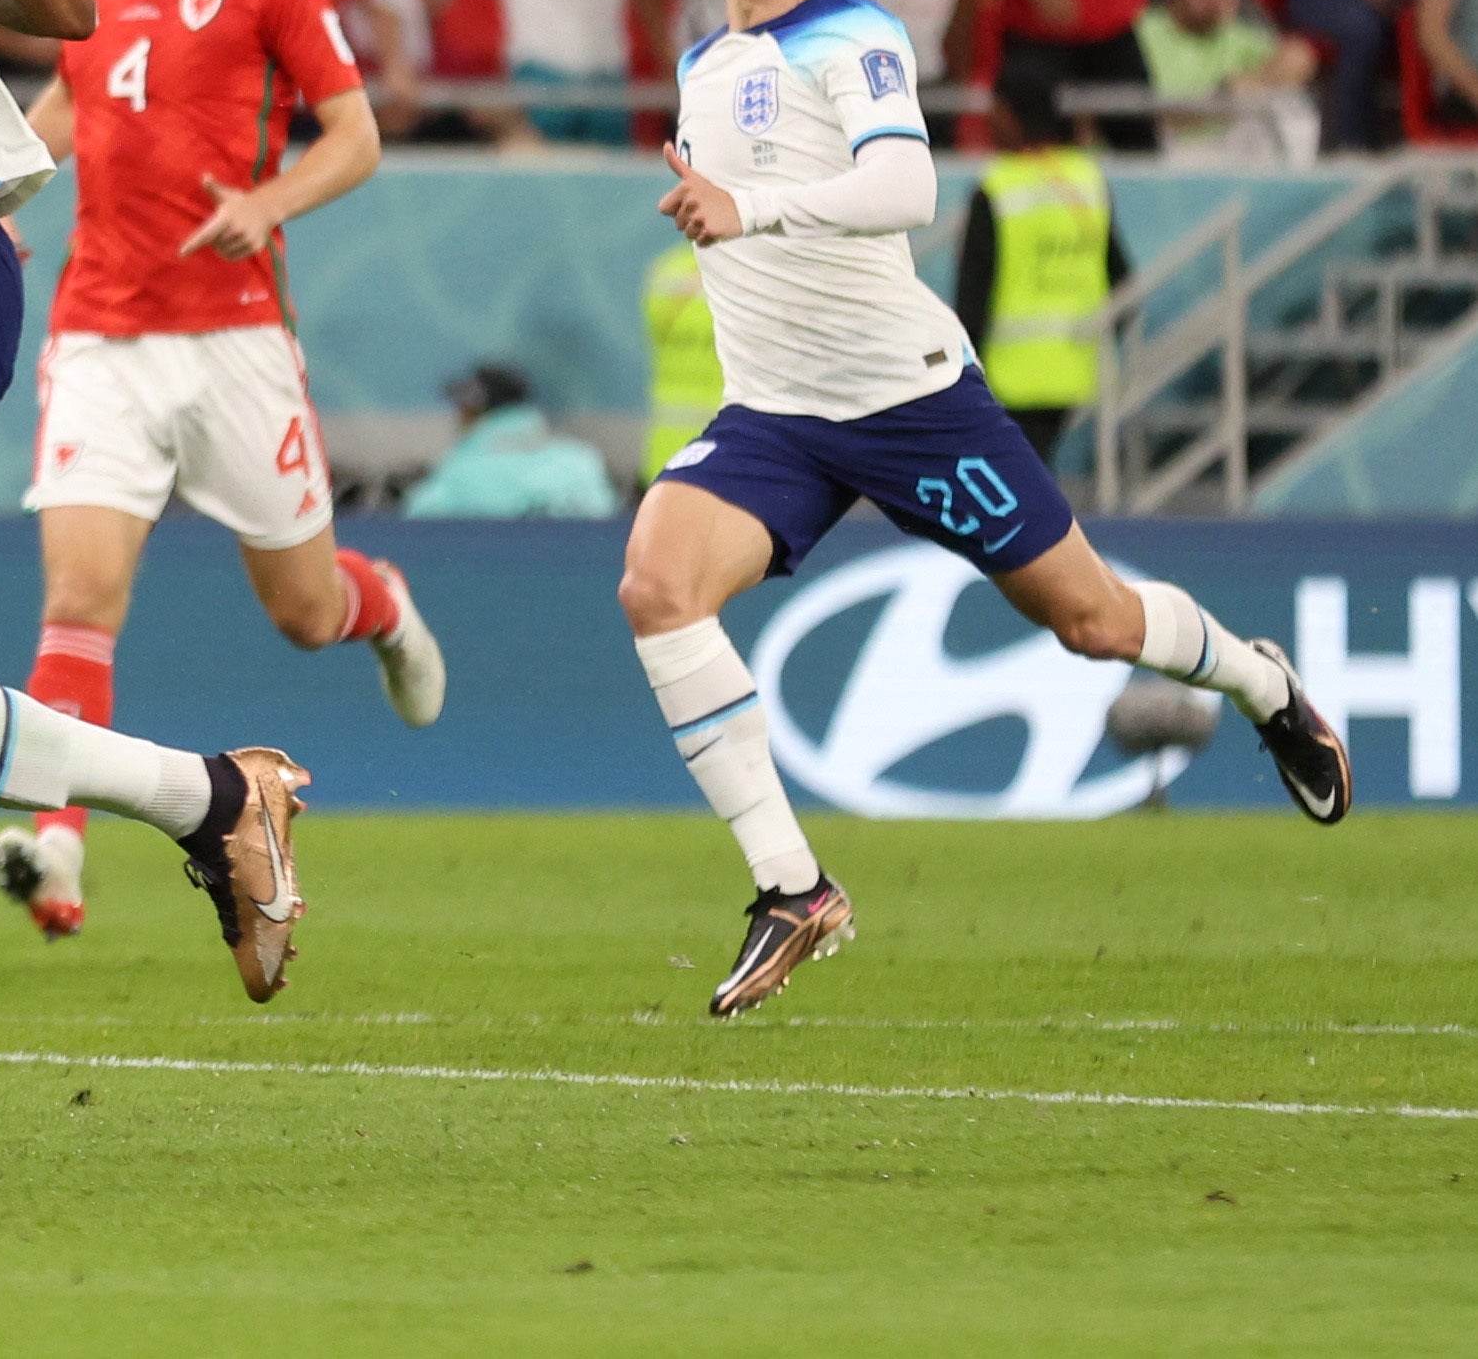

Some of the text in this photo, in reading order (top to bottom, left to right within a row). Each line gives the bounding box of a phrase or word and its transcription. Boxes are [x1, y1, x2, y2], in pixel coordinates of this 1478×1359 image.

[107, 37, 151, 113] 4
[276, 416, 310, 479] 4
[916, 456, 1018, 535] 20
[1296, 575, 1478, 799] H
